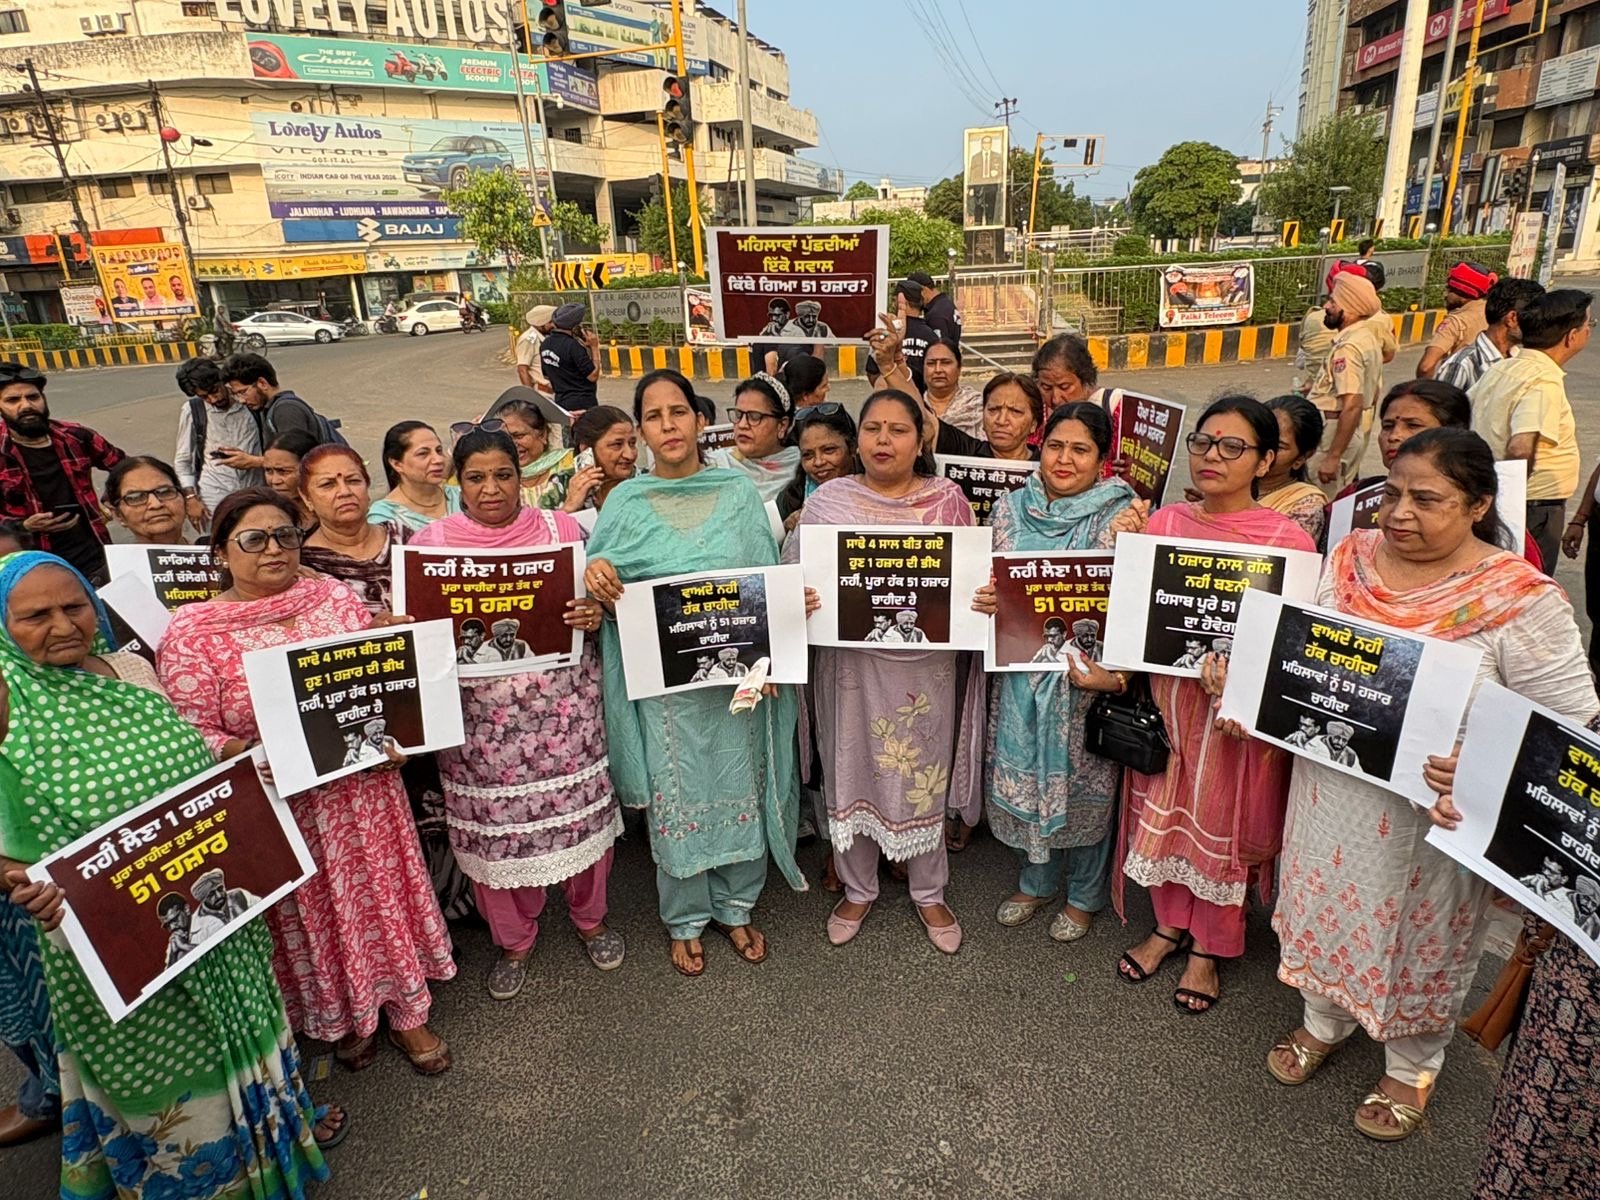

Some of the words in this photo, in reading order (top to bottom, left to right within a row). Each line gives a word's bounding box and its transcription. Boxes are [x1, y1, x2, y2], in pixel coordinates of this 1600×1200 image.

[461, 65, 500, 76] ELECTRIC
[462, 58, 497, 67] PREMIUM
[465, 75, 499, 83] SCOOTER
[268, 121, 330, 143] Lovely
[334, 122, 382, 139] Autos
[271, 147, 389, 156] VICTORIS
[289, 206, 334, 217] JALANDHAR
[340, 207, 376, 217] LUDHIANA
[382, 206, 430, 216] NAWANSHAHR
[385, 223, 444, 235] BAJAJ
[737, 235, 798, 252] ਮਹਿਲਾਵਾਂ
[801, 234, 860, 255] ਪੁੱਛਦੀਆਂ
[763, 256, 790, 273] ਇੱਕੋ
[794, 260, 834, 273] ਸਵਾਲ
[1398, 265, 1425, 276] BHARAT
[727, 275, 755, 291] ਕਿੱਥੇ
[759, 275, 798, 292] ਗਿਆ
[801, 280, 817, 292] 51
[653, 291, 678, 300] CHOWK
[653, 306, 680, 315] BHARAT
[1133, 421, 1148, 437] AAP
[846, 536, 866, 549] ਸਾਢੇ
[868, 539, 877, 549] 4
[879, 539, 900, 549] ਸਾਲ
[902, 536, 922, 550] ਬੀਤ
[924, 536, 945, 550] ਗਏ
[422, 558, 457, 577] ਨਹੀਂ
[460, 558, 496, 577] ਲੈਣਾ
[500, 563, 508, 577] 1
[512, 559, 555, 576] ਹਜ਼ਾਰ
[849, 557, 866, 571] ਹੁਣ
[867, 557, 873, 568] 1
[875, 558, 904, 569] ਹਜ਼ਾਰ
[906, 555, 919, 569] ਦੀ
[920, 555, 941, 569] ਭੀਖ
[1008, 559, 1038, 579] ਨਹੀਂ
[1040, 559, 1071, 578] ਲੈਣਾ
[1074, 564, 1082, 578] 1
[1168, 553, 1175, 565] 1
[1177, 554, 1214, 568] ਹਜ਼ਾਰ
[1216, 558, 1244, 572] ਨਾਲ
[1247, 558, 1274, 575] ਗੱਲ
[441, 583, 461, 596] ਪੂਰਾ
[463, 581, 497, 593] ਚਾਹੀਦਾ
[499, 582, 514, 594] ਹੁਣ
[516, 580, 531, 590] ਤੱਕ
[532, 580, 544, 589] ਦਾ
[681, 581, 713, 598] ਵਾਅਦੇ
[865, 576, 885, 590] ਪੂਰਾ
[887, 573, 905, 587] ਹੱਕ
[907, 577, 919, 587] 51
[920, 577, 950, 588] ਹਜ਼ਾਰ
[1025, 583, 1042, 596] ਪੂਰਾ
[1044, 581, 1073, 592] ਚਾਹੀਦਾ
[1075, 583, 1089, 594] ਹੁਣ
[1091, 581, 1105, 592] ਤੱਕ
[1185, 572, 1212, 590] ਨਹੀਂ
[450, 597, 473, 614] 51
[479, 594, 535, 614] ਹਜ਼ਾਰ
[682, 601, 701, 615] ਹੱਕ
[703, 597, 740, 612] ਚਾਹੀਦਾ
[871, 592, 906, 606] ਚਾਹੀਦਾ
[908, 591, 918, 606] ਹੈ
[1034, 597, 1055, 613] 51
[1155, 588, 1195, 608] ਹਿਸਾਬ
[1197, 594, 1218, 614] ਪੂਰੇ
[1221, 600, 1237, 613] 51
[668, 617, 708, 634] ਮਹਿਲਾਵਾਂ
[719, 617, 730, 627] 51
[731, 616, 757, 625] ਹਜ਼ਾਰ
[1184, 616, 1199, 629] ਦਾ
[699, 632, 730, 645] ਚਾਹੀਦਾ
[1311, 623, 1352, 646] ਵਾਅਦੇ
[297, 651, 320, 668] ਸਾਢੇ
[322, 652, 331, 663] 4
[333, 647, 357, 661] ਸਾਲ
[359, 641, 382, 656] ਬੀਤ
[384, 636, 406, 652] ਗਏ
[1304, 641, 1328, 662] ਹੱਕ
[1329, 651, 1378, 676] ਚਾਹੀਦਾ
[304, 675, 323, 692] ਹੁਣ
[324, 673, 331, 684] 1
[332, 666, 364, 682] ਹਜ਼ਾਰ
[365, 660, 380, 675] ਦੀ
[381, 658, 405, 673] ਭੀਖ
[1282, 660, 1329, 684] ਮਹਿਲਾਵਾਂ
[1329, 673, 1340, 693] ਨੂੰ
[1341, 680, 1356, 694] 51
[1358, 685, 1393, 706] ਹਜ਼ਾਰ
[325, 690, 347, 710] ਪੂਰਾ
[348, 684, 367, 699] ਹੱਕ
[369, 683, 383, 695] 51
[384, 678, 417, 692] ਹਜ਼ਾਰ
[1311, 692, 1350, 713] ਚਾਹੀਦਾ
[335, 705, 371, 724] ਚਾਹੀਦਾ
[373, 698, 384, 713] ਹੈ
[1558, 768, 1588, 797] ਹੱਕ
[1525, 782, 1587, 824] ਮਹਿਲਾਵਾਂ
[76, 837, 120, 880] ਨਹੀਂ
[117, 818, 162, 854] ਲੈਣਾ
[164, 810, 180, 827] 1
[178, 779, 233, 819] ਹਜ਼ਾਰ
[110, 865, 134, 890] ਪੂਰਾ
[133, 841, 174, 870] ਚਾਹੀਦਾ
[173, 828, 195, 849] ਹੁਣ
[194, 818, 214, 835] ਤੱਕ
[213, 809, 228, 823] ਦਾ
[128, 872, 162, 905] 51
[159, 830, 229, 882] ਹਜ਼ਾਰ
